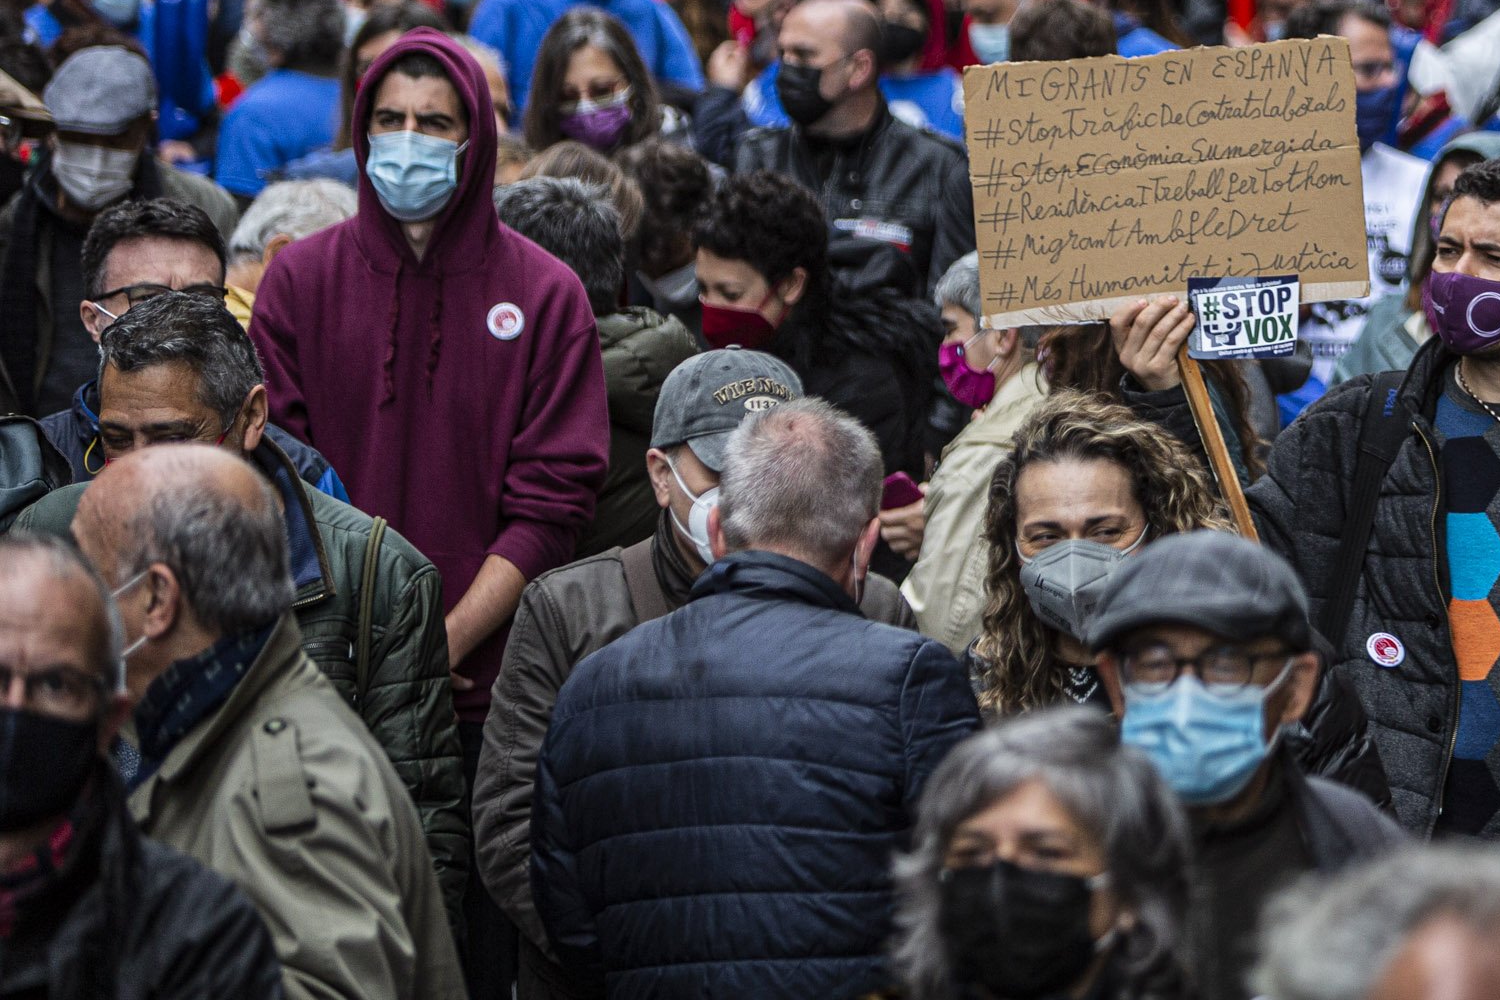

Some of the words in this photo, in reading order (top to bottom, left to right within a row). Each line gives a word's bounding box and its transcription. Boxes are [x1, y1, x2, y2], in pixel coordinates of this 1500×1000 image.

[985, 61, 1150, 101] MIGRANTS
[1163, 59, 1194, 85] EN
[1212, 44, 1336, 86] ESPANYA
[1203, 286, 1291, 321] #STOP
[1243, 313, 1294, 345] VOX
